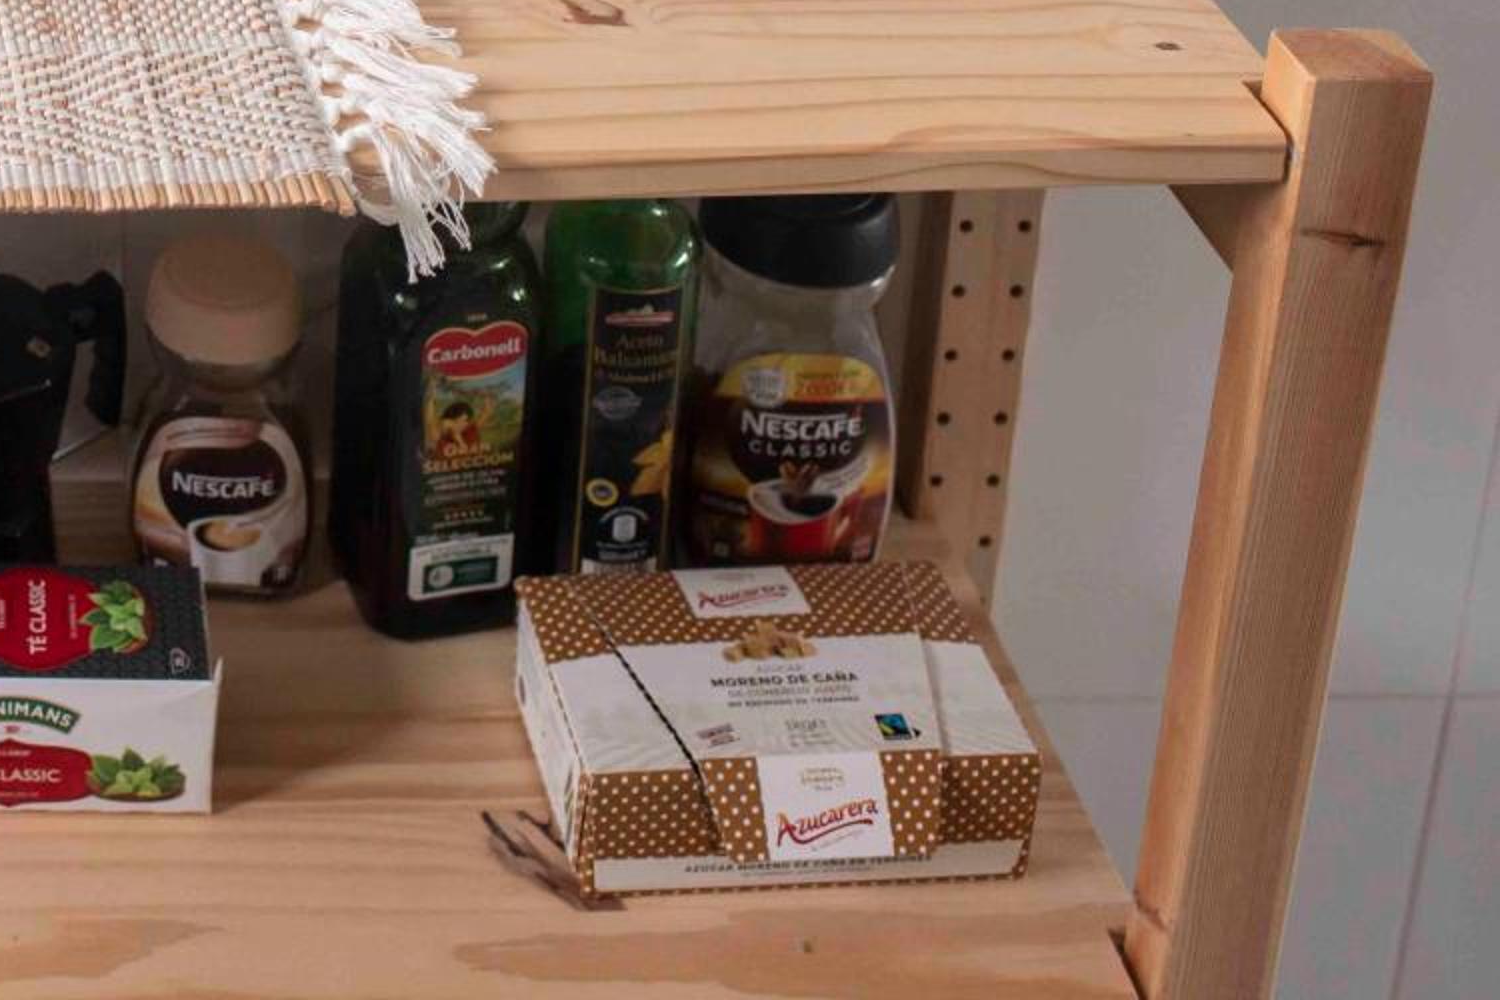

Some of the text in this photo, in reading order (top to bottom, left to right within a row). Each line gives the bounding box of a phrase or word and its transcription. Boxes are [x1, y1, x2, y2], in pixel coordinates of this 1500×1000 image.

[426, 338, 521, 364] Carbonell
[741, 404, 862, 441] NESCAFÉ
[748, 441, 852, 459] CLASSIC
[171, 470, 277, 500] NESCAFÉ
[29, 580, 47, 633] CLASSIC
[710, 674, 784, 688] MORENO
[786, 674, 808, 686] DE
[777, 797, 879, 847] Azucarera
